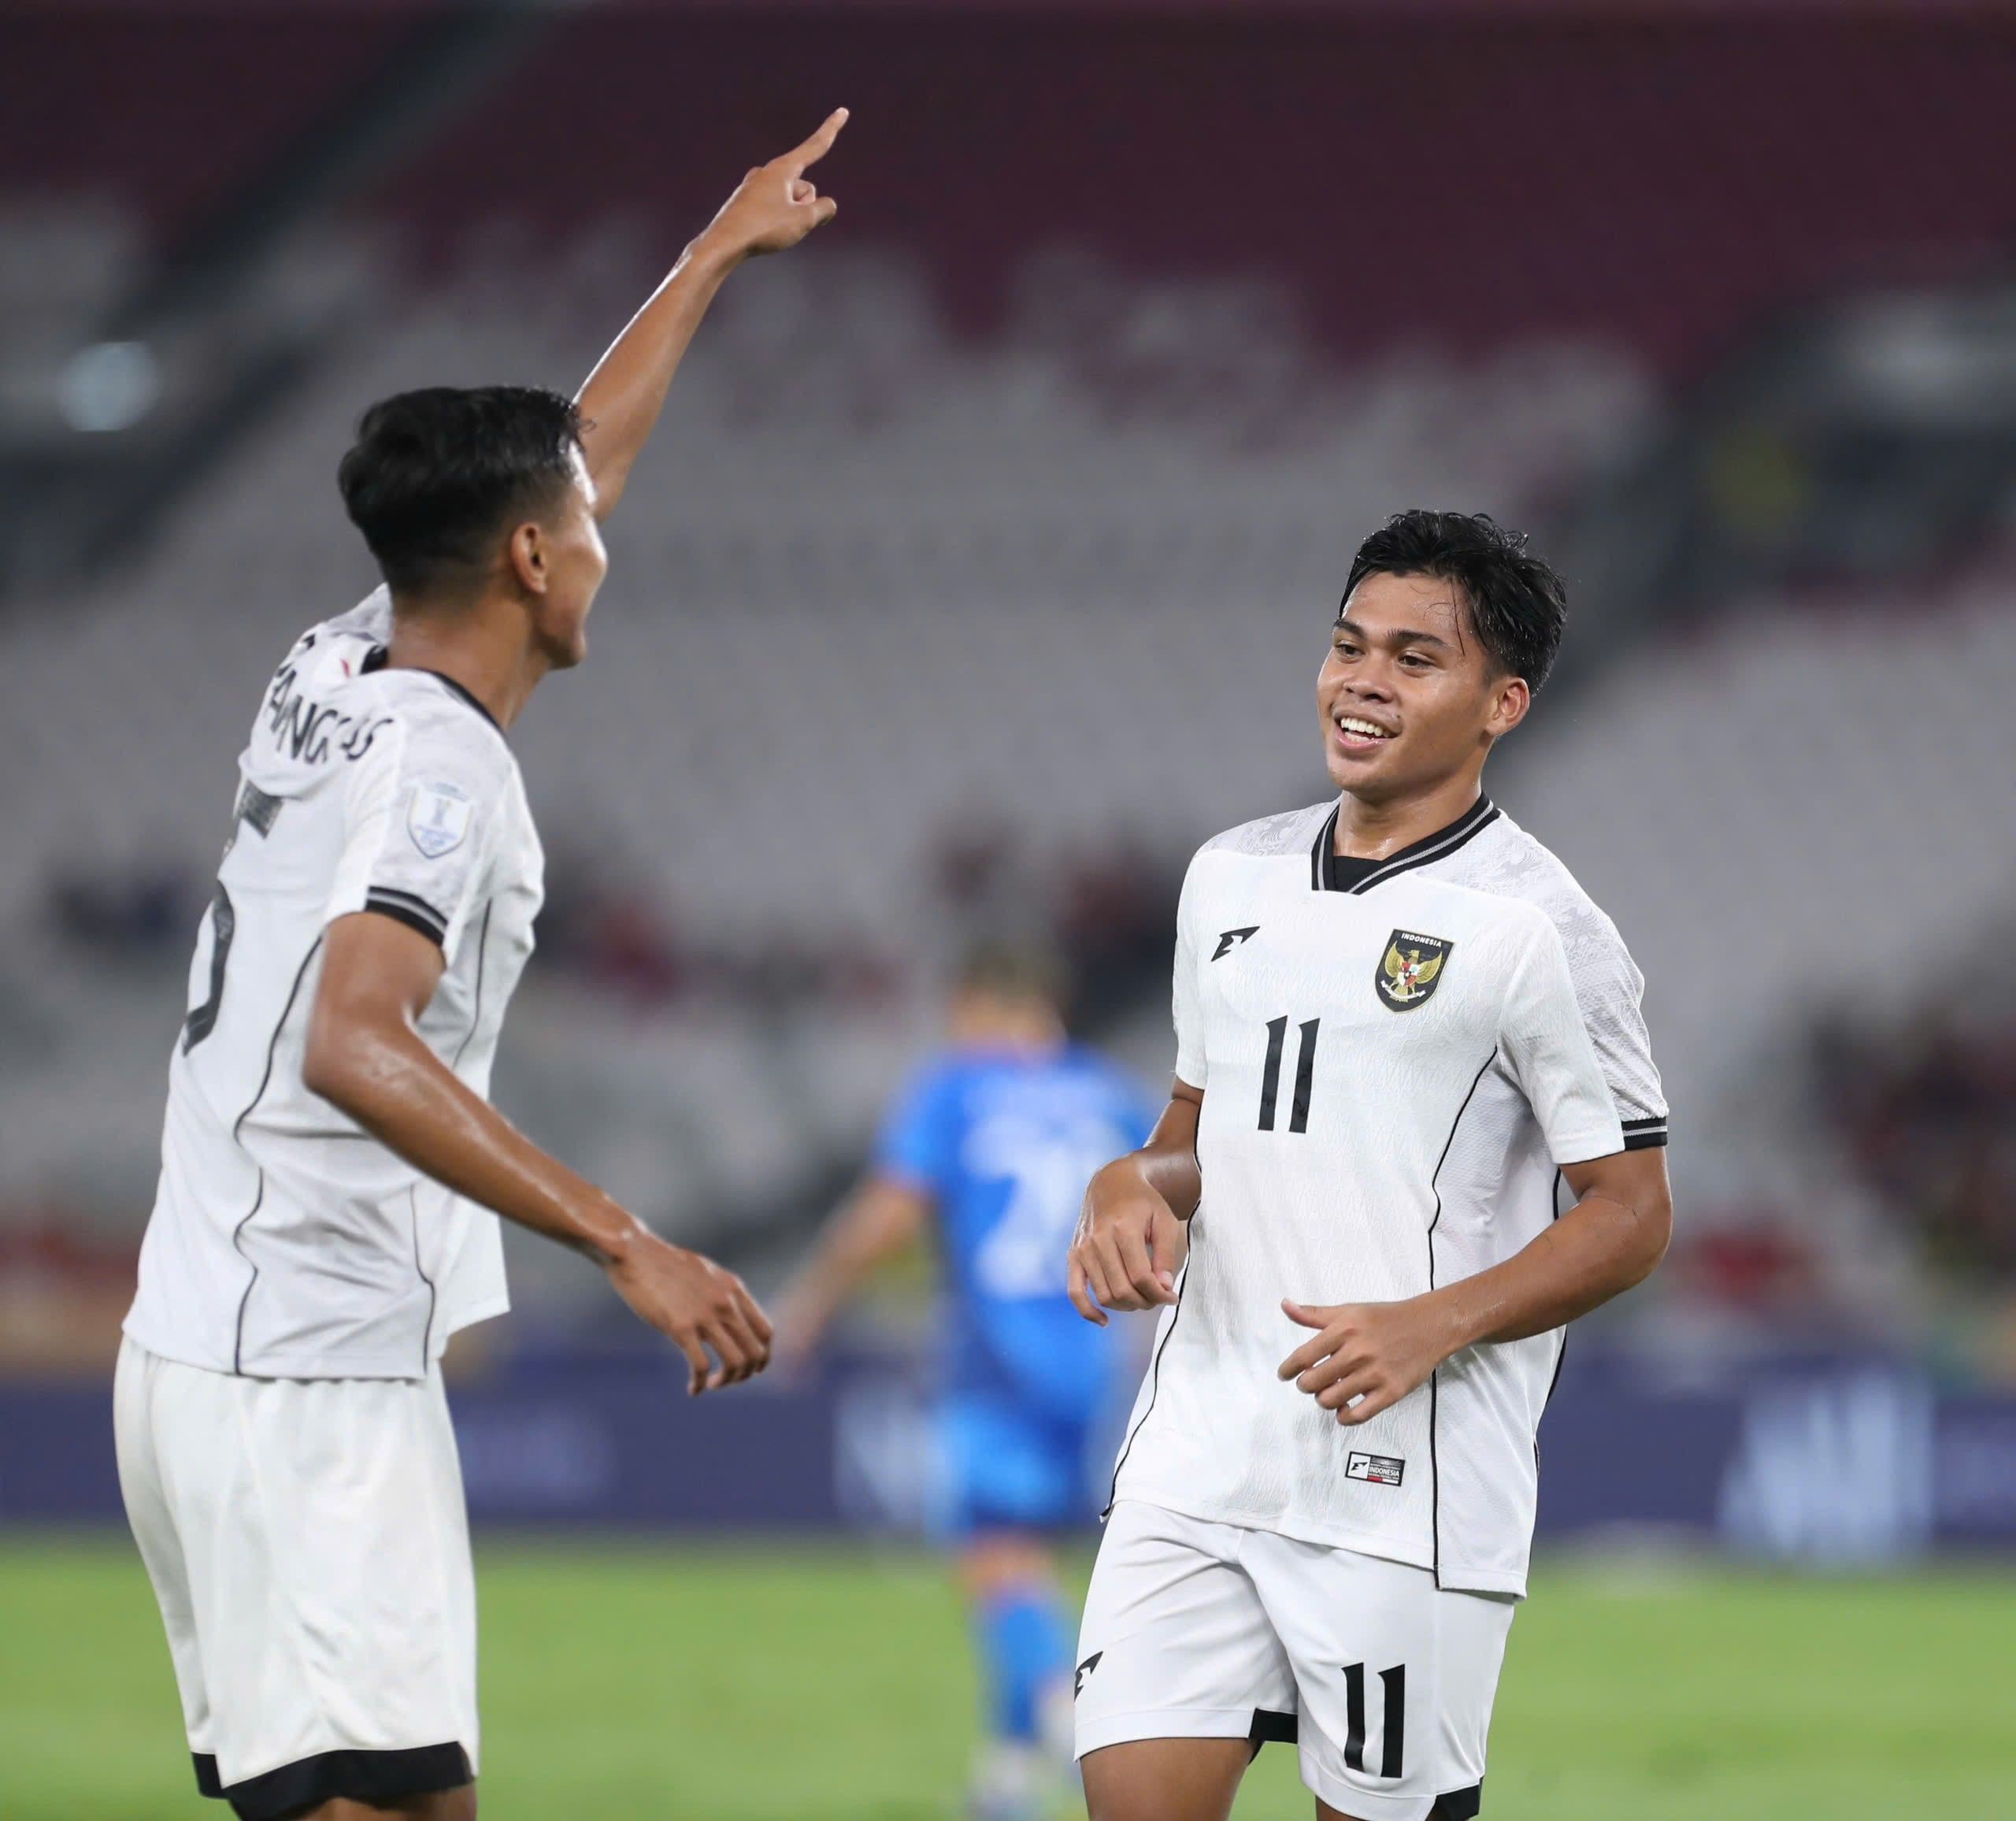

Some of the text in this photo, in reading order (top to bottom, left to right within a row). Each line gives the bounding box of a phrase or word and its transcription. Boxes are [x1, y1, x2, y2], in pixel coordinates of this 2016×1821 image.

[1401, 933, 1442, 948] INDONESIA
[1258, 1015, 1321, 1133] 11
[1369, 1467, 1400, 1478] INDONESIA
[1341, 1662, 1405, 1778] 11
